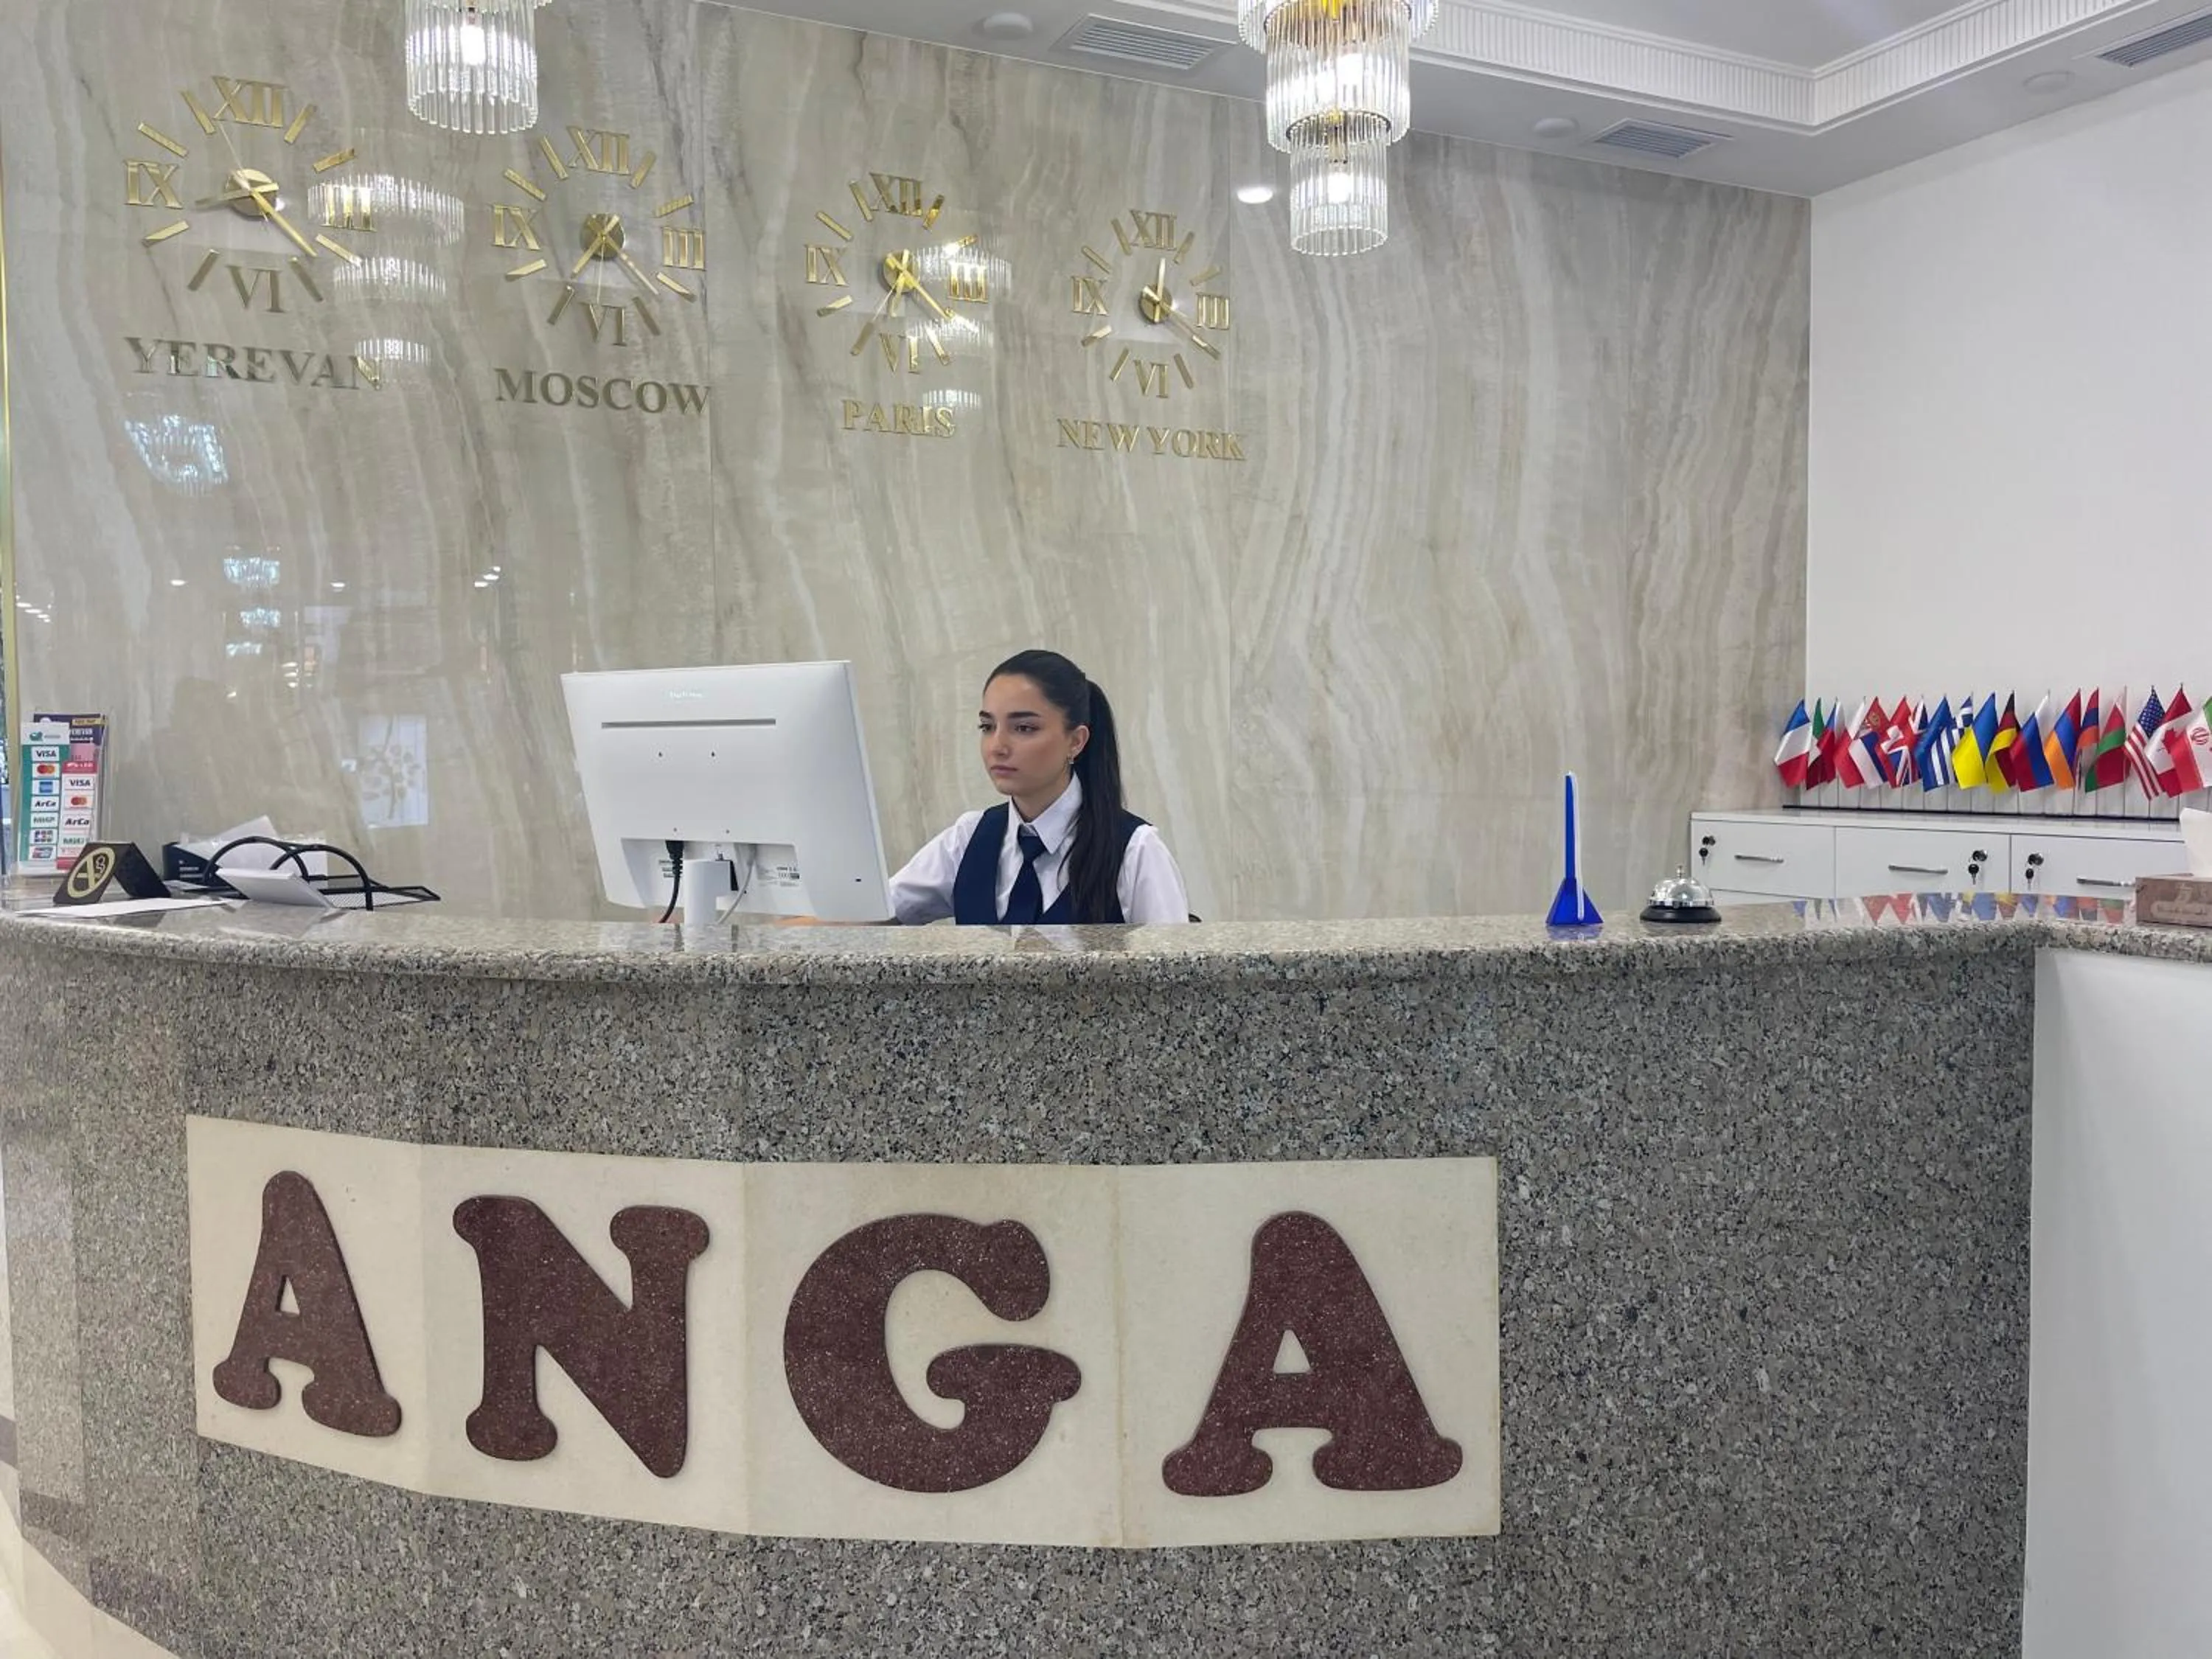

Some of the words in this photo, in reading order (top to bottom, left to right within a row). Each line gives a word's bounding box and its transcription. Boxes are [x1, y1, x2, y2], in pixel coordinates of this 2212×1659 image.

[213, 76, 289, 128] XII
[566, 126, 630, 175] XII
[124, 160, 183, 209] IX
[869, 173, 922, 217] XII
[492, 204, 541, 251] IX
[662, 226, 706, 271] III
[1130, 209, 1177, 251] XII
[805, 245, 849, 287] IX
[226, 265, 287, 313] VI
[1071, 276, 1109, 316] IX
[580, 302, 627, 346] VI
[1195, 293, 1230, 330] III
[124, 337, 382, 391] YEREVAN
[879, 333, 920, 375] VI
[493, 367, 711, 415] MOSCOW
[1133, 359, 1169, 398] VI
[841, 398, 956, 438] PARIS
[1057, 418, 1140, 453] NEW
[1147, 425, 1246, 462] YORK
[35, 750, 57, 758] VISA
[69, 778, 91, 787] VISA
[65, 818, 89, 826] ArCa
[212, 1169, 1464, 1495] ANGA
